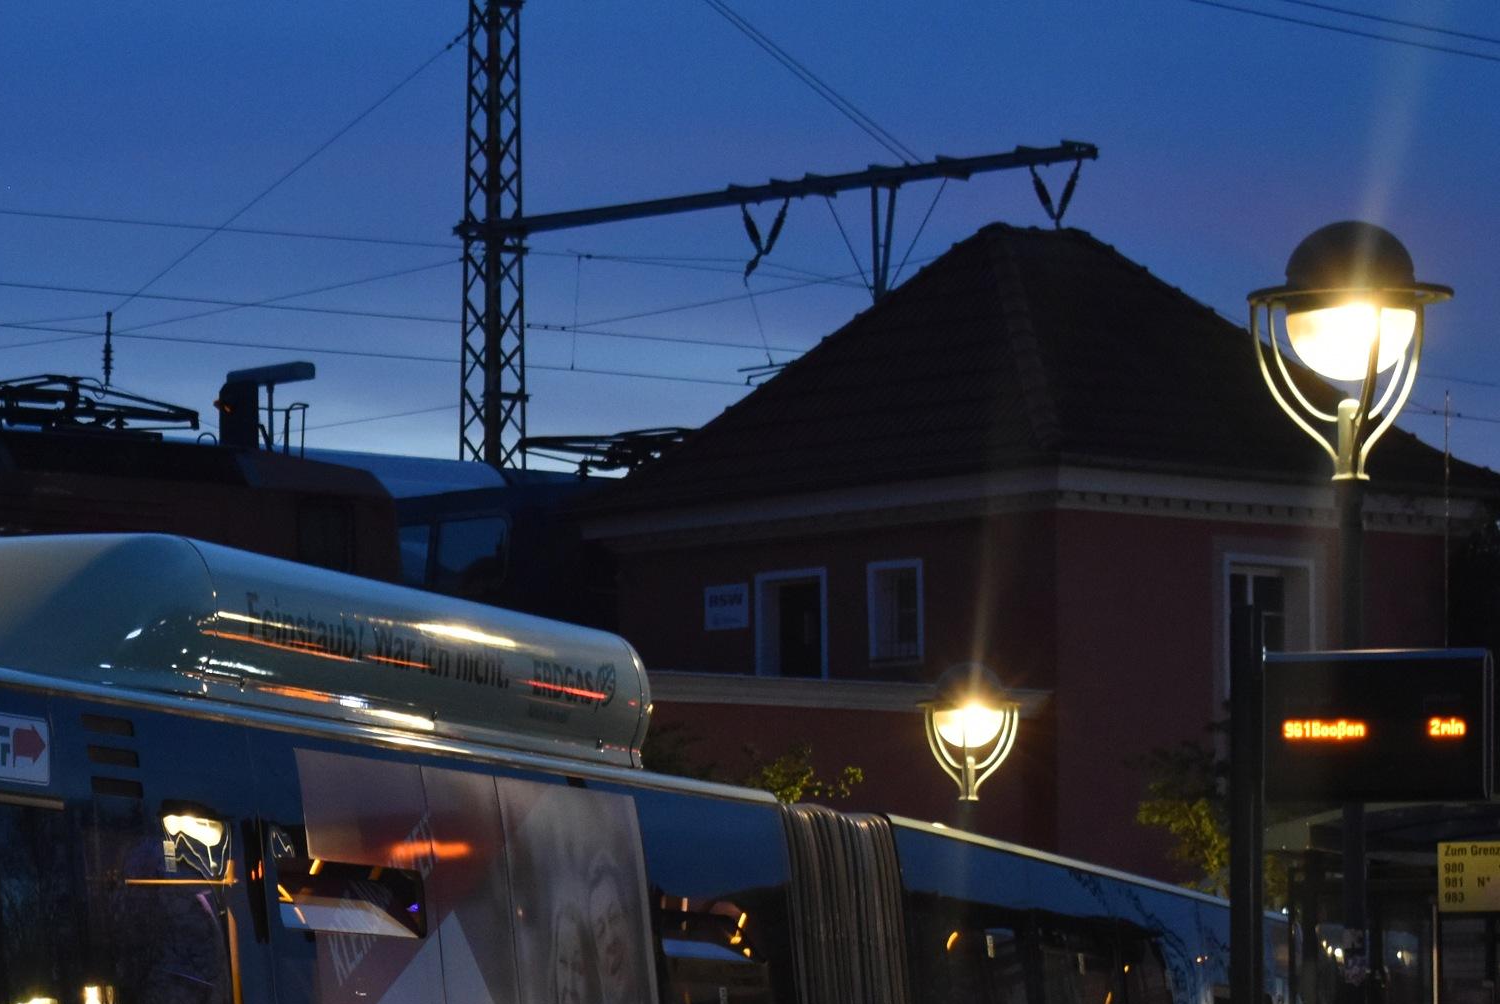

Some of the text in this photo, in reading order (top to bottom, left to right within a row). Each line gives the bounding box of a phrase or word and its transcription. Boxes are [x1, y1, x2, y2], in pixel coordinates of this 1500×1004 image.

[246, 591, 365, 660] Feinstaub!
[373, 620, 417, 671] War
[533, 660, 593, 705] ERDGAS
[1445, 845, 1467, 857] Zum
